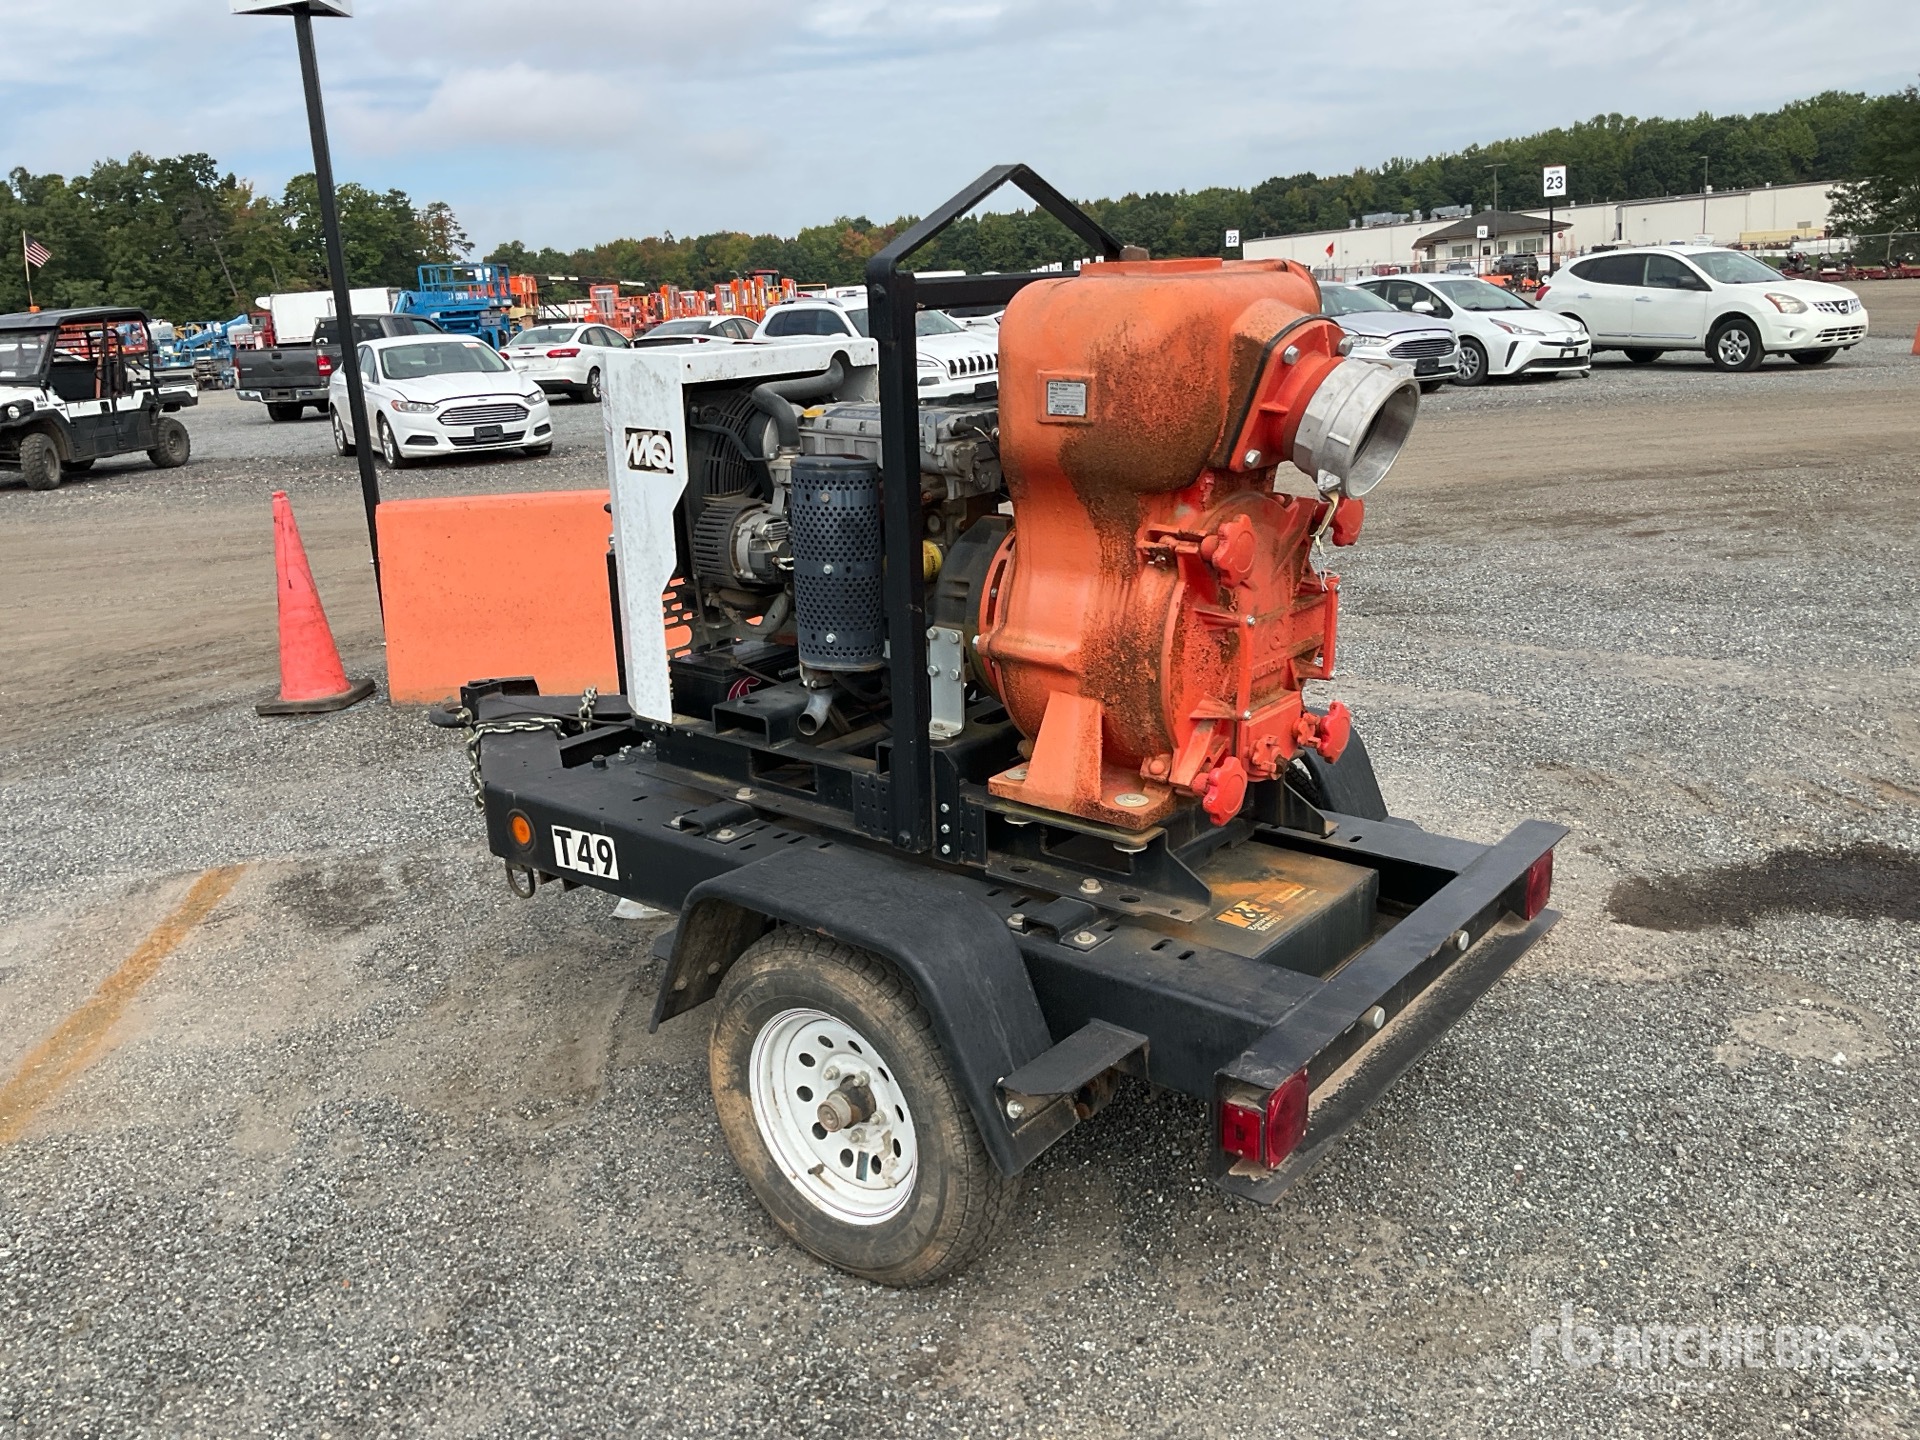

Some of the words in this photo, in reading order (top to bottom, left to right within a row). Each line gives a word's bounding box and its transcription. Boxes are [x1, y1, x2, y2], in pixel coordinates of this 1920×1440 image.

[1546, 175, 1563, 190] 23
[1227, 235, 1238, 244] 22
[625, 432, 676, 470] MQ
[553, 828, 613, 876] T49
